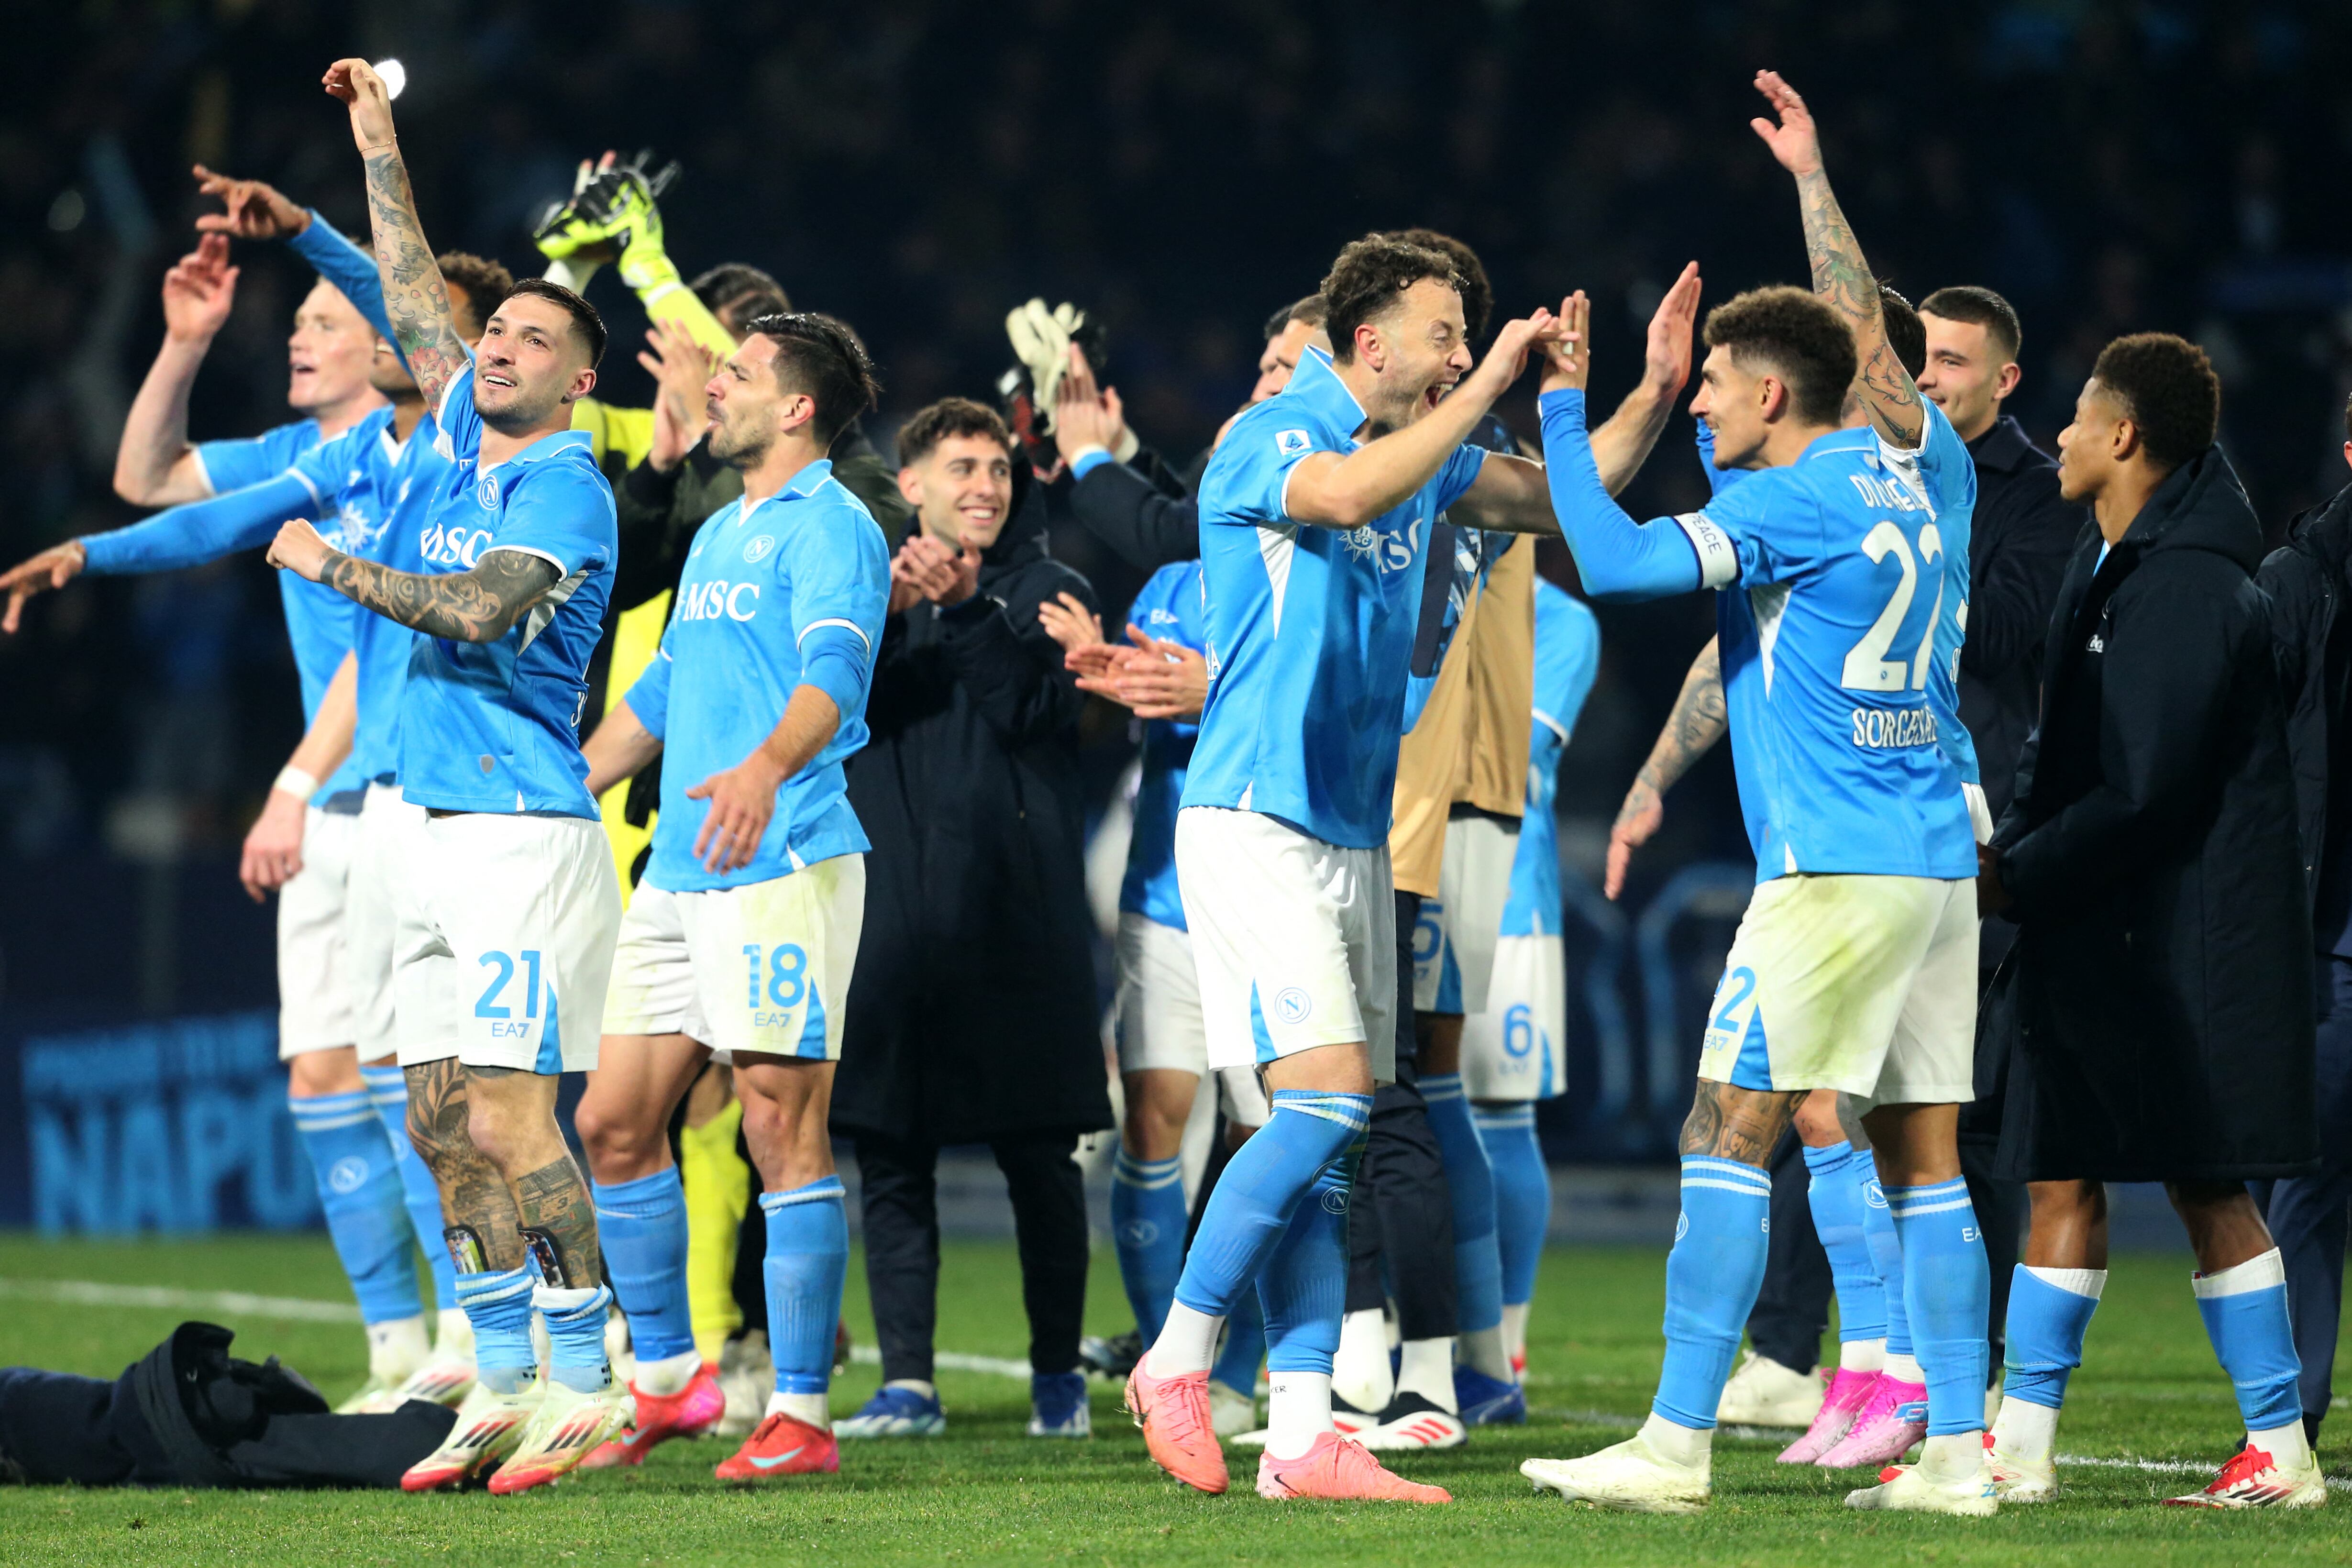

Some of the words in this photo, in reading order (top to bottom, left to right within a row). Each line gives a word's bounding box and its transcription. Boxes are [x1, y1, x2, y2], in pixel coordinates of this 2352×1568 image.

[682, 580, 760, 622] MSC
[475, 950, 541, 1018] 21
[742, 943, 807, 1008] 18
[492, 1022, 530, 1038] EA7
[754, 1012, 792, 1027] EA7
[1503, 1004, 1532, 1059] 6
[1704, 1034, 1729, 1051] EA7
